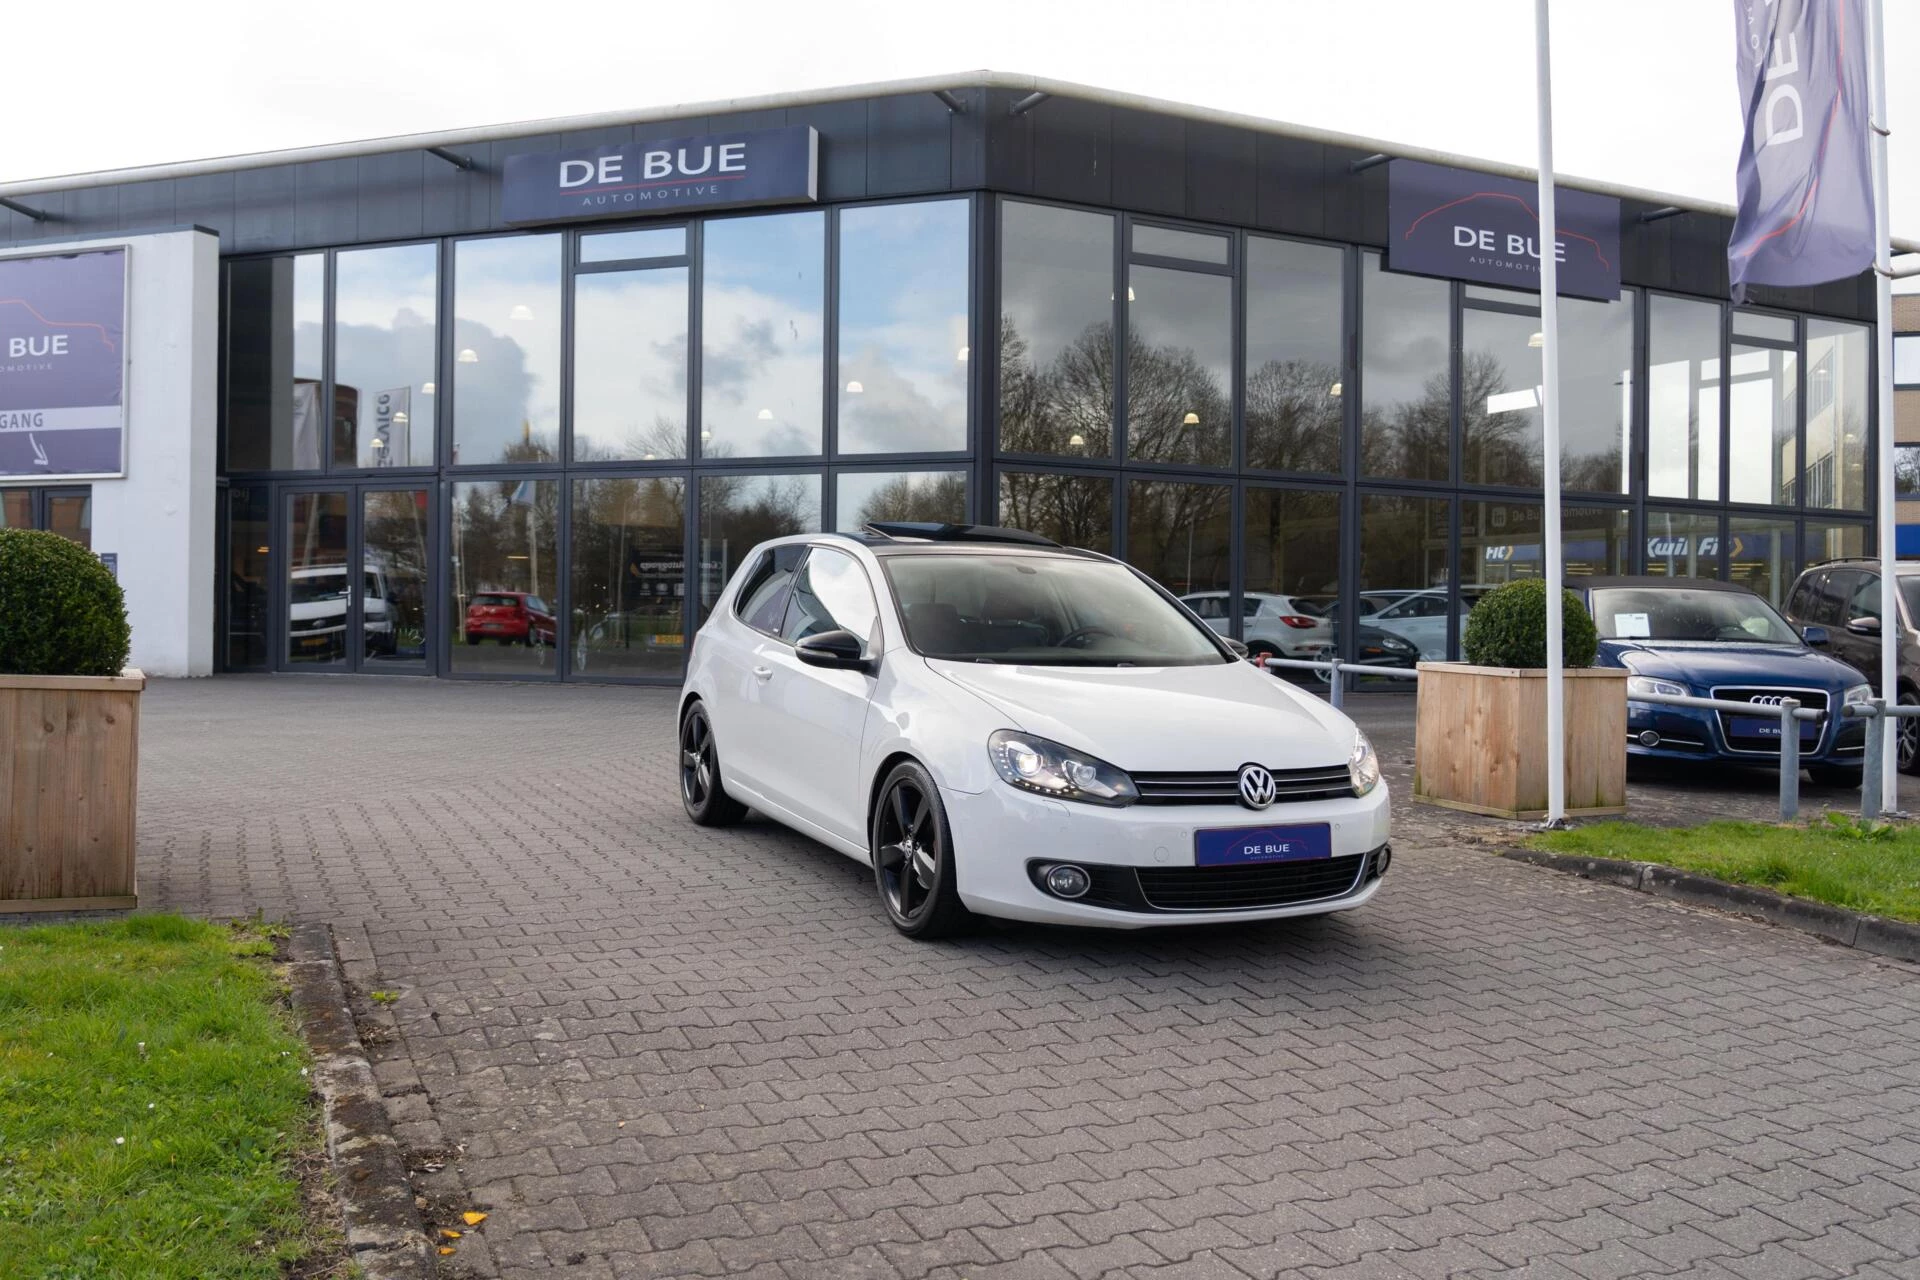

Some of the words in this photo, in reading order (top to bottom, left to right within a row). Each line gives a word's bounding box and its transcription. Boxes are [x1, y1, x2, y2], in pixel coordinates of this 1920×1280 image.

[559, 155, 623, 188] DE
[643, 142, 747, 180] BUE
[582, 184, 720, 207] AUTOMOTIVE
[1453, 225, 1496, 251] DE
[1469, 255, 1543, 273] AUTOMOTI
[9, 335, 68, 357] BUE
[1697, 537, 1720, 556] Fi
[1244, 846, 1261, 855] DE
[1265, 844, 1290, 853] BUE
